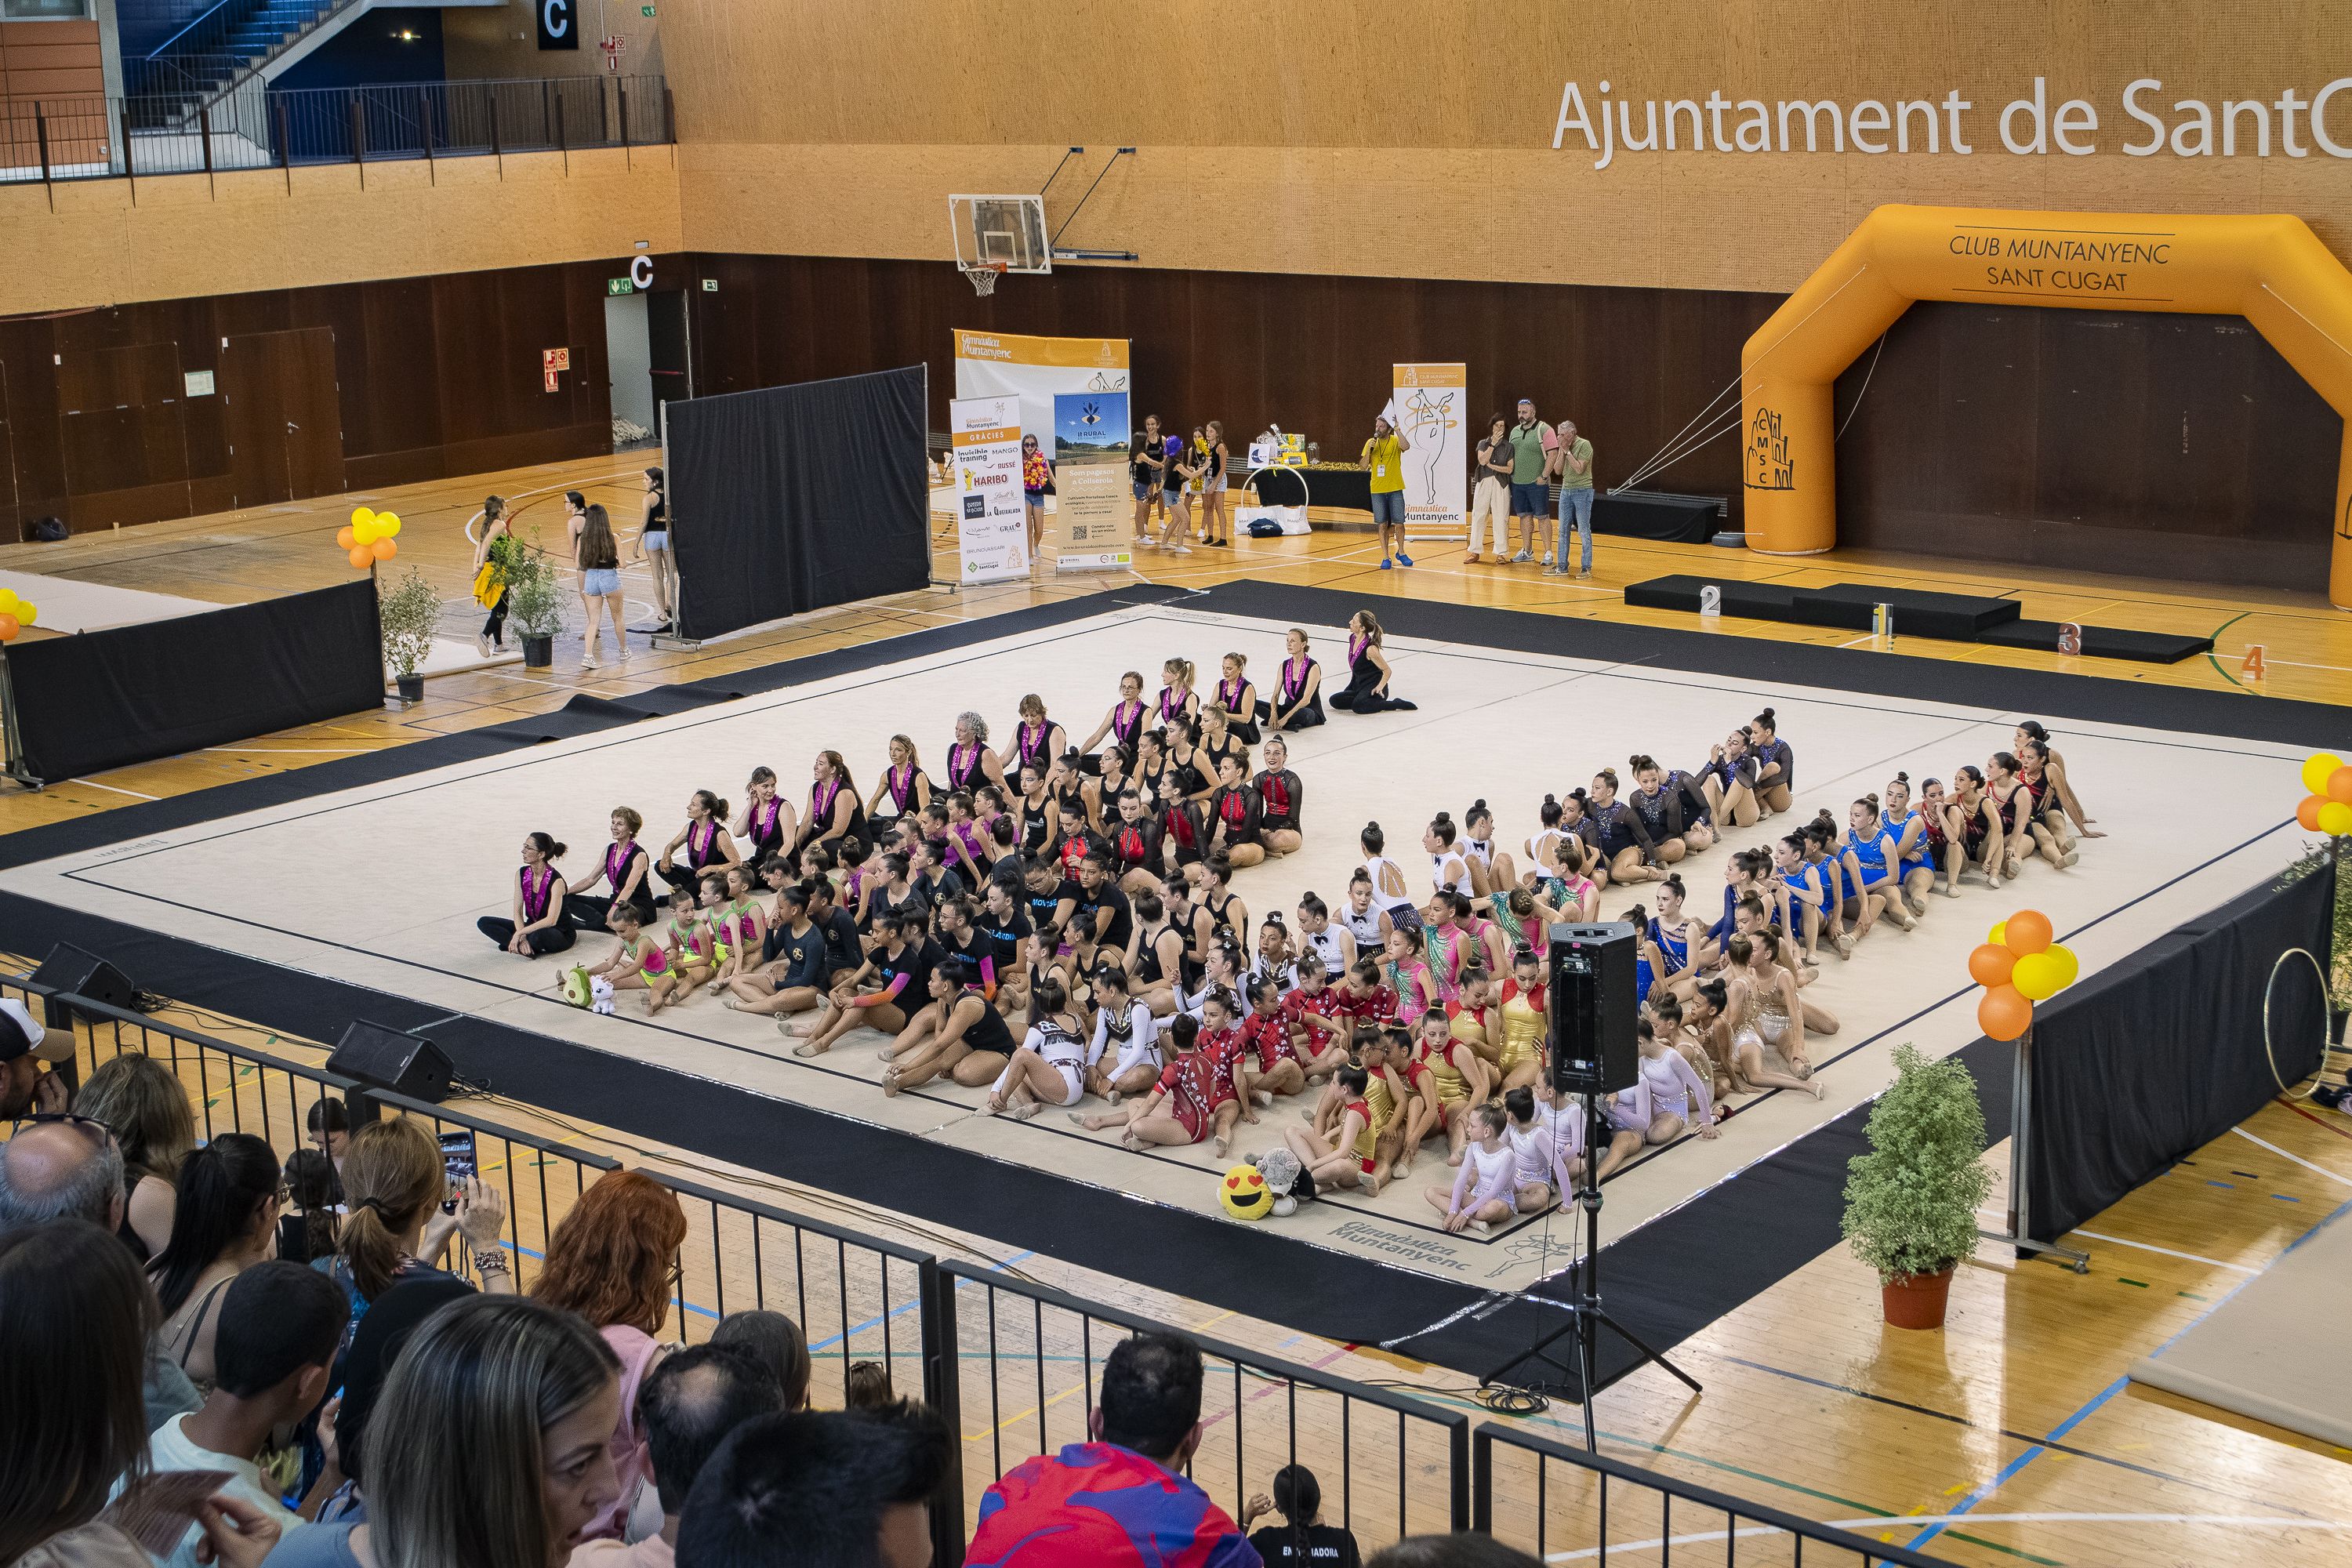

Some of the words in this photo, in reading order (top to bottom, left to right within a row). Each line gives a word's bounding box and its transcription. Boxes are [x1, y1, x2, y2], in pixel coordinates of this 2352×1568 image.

[544, 0, 568, 38] C
[1551, 81, 1973, 170] Ajuntament
[1998, 77, 2098, 155] de
[1950, 235, 2000, 256] CLUB
[2006, 238, 2171, 265] MUNTANYENC
[630, 255, 654, 289] C
[1987, 267, 2044, 288] SANT
[2051, 270, 2128, 292] CUGAT
[961, 343, 1012, 360] Muntanyenc
[966, 421, 1000, 430] Muntanyenc
[970, 431, 1004, 441] GRÀCIES
[974, 474, 1008, 486] HARIBO
[1700, 585, 1721, 616] 2
[1873, 603, 1888, 635] 1
[2057, 622, 2082, 655] 3
[2241, 644, 2267, 681] 4
[1032, 898, 1058, 908] MONSE
[1327, 1226, 1472, 1271] Muntanyenc
[1342, 1221, 1459, 1256] Gimnàstica
